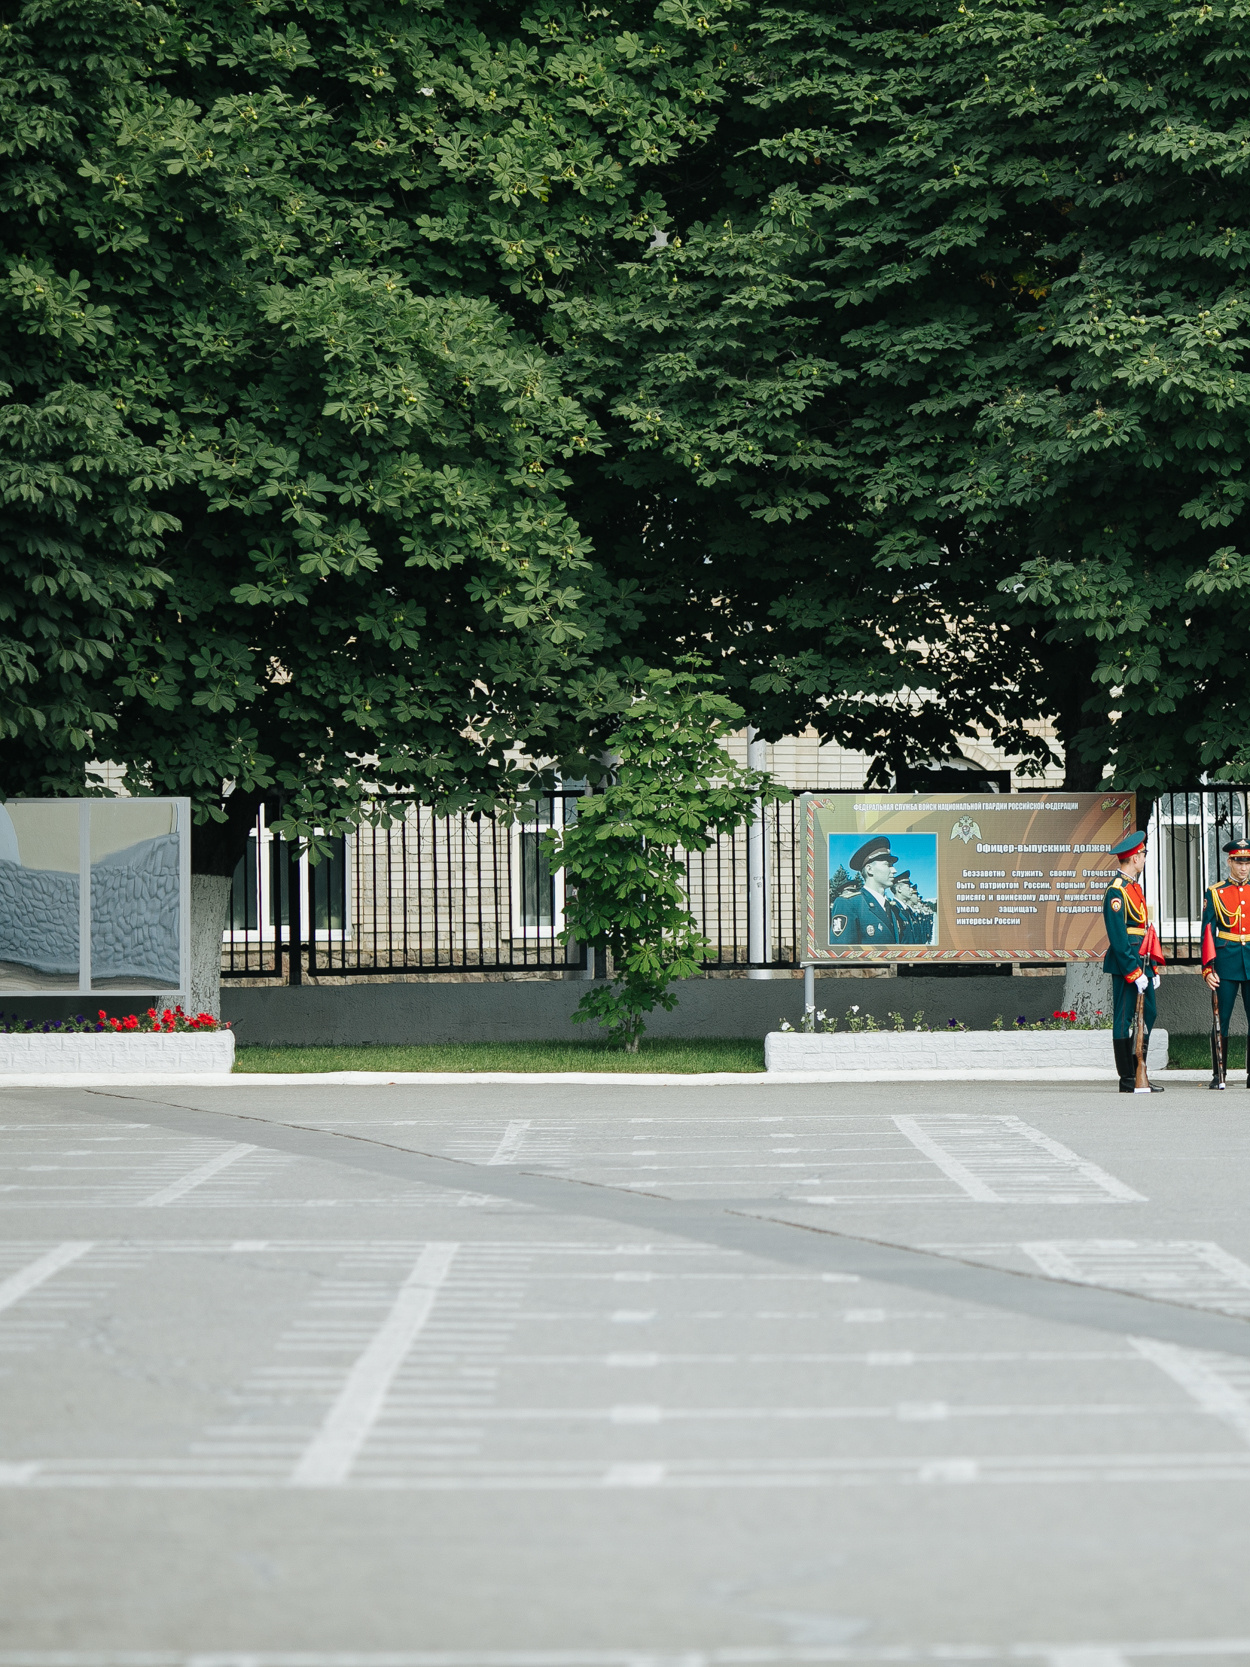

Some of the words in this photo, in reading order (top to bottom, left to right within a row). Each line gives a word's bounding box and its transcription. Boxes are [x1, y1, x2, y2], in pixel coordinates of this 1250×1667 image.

[853, 803, 894, 811] ФЕДЕРАЛЬНАЯ
[895, 803, 918, 811] СЛУЖБА
[918, 802, 937, 811] ВОЙСК
[938, 803, 982, 811] НАЦИОНАЛЬНОЙ
[983, 803, 1007, 811] ГВАРДИИ
[1008, 802, 1044, 810] РОССИЙСКОЙ
[1045, 803, 1078, 811] ФЕДЕРАЦИИ
[976, 843, 1071, 854] Офицер-выпускник
[1073, 844, 1111, 853] должен
[962, 869, 1006, 878] Беззаветно
[1082, 869, 1118, 877] Отечеств
[1024, 881, 1051, 889] России,
[1090, 881, 1109, 889] Воен
[956, 906, 980, 914] умело
[956, 918, 993, 926] интересы
[994, 917, 1021, 925] России
